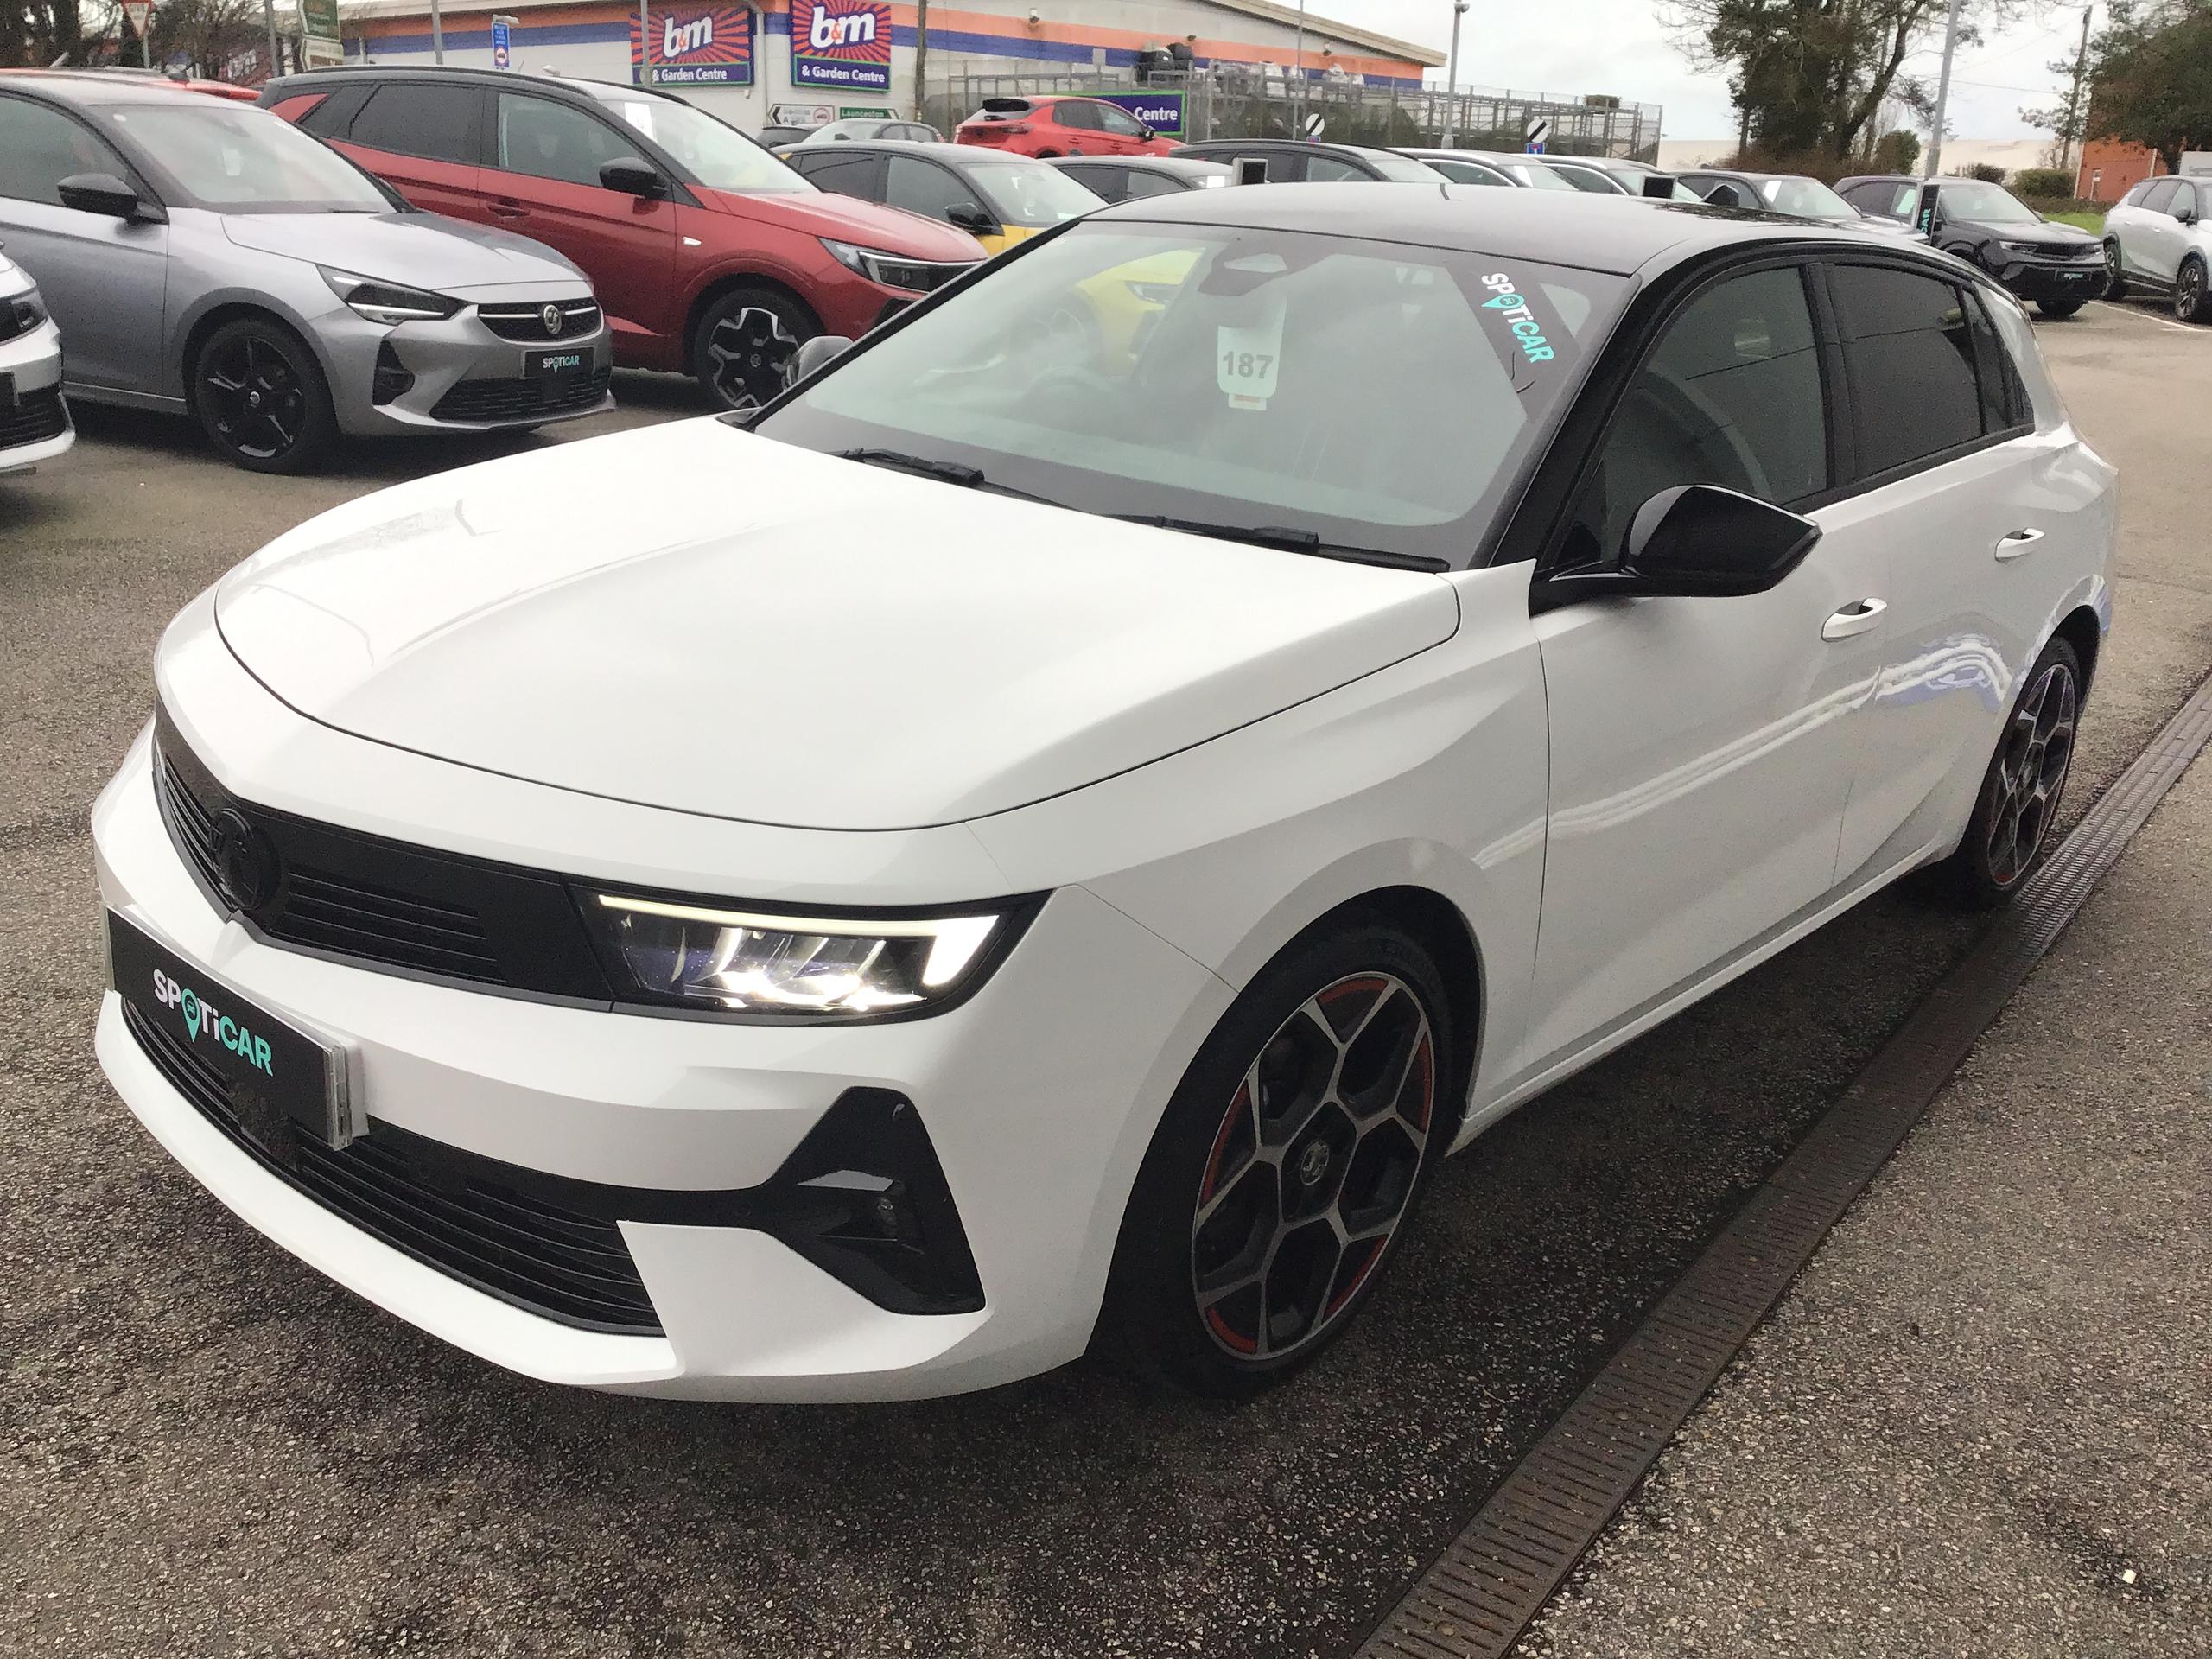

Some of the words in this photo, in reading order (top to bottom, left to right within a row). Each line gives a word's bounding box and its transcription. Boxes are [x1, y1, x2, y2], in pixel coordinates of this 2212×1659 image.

[664, 16, 713, 58] b&m
[810, 6, 875, 48] b&m
[652, 69, 660, 81] &
[661, 68, 694, 81] Garden
[696, 68, 728, 81] Centre
[802, 65, 810, 77] &
[812, 67, 849, 79] Garden
[852, 69, 886, 83] Centre
[1135, 106, 1178, 121] Centre
[1223, 351, 1274, 379] 187
